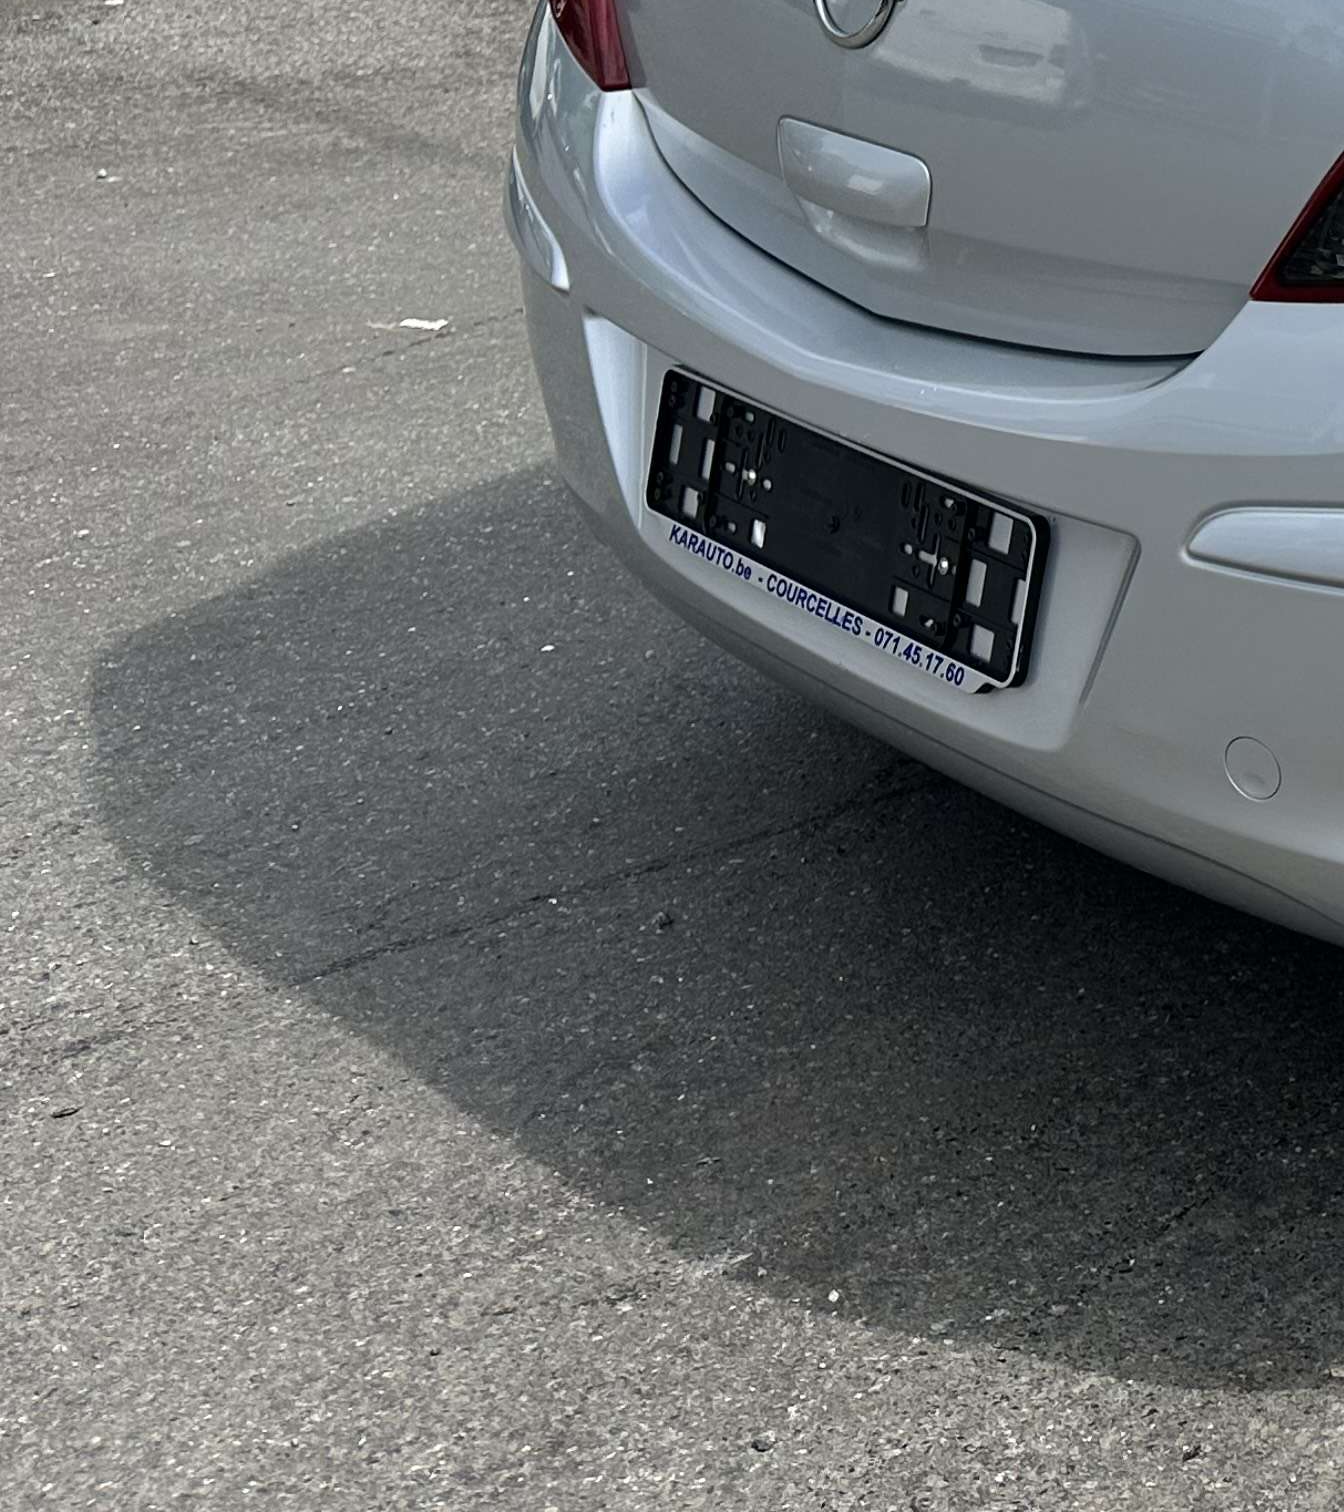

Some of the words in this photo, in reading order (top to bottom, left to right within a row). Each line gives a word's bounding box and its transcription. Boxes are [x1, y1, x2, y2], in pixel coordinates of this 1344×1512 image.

[668, 523, 753, 582] KARAUTO.be
[766, 572, 863, 636] COURCELLES
[873, 627, 965, 687] 071.45.17.60
